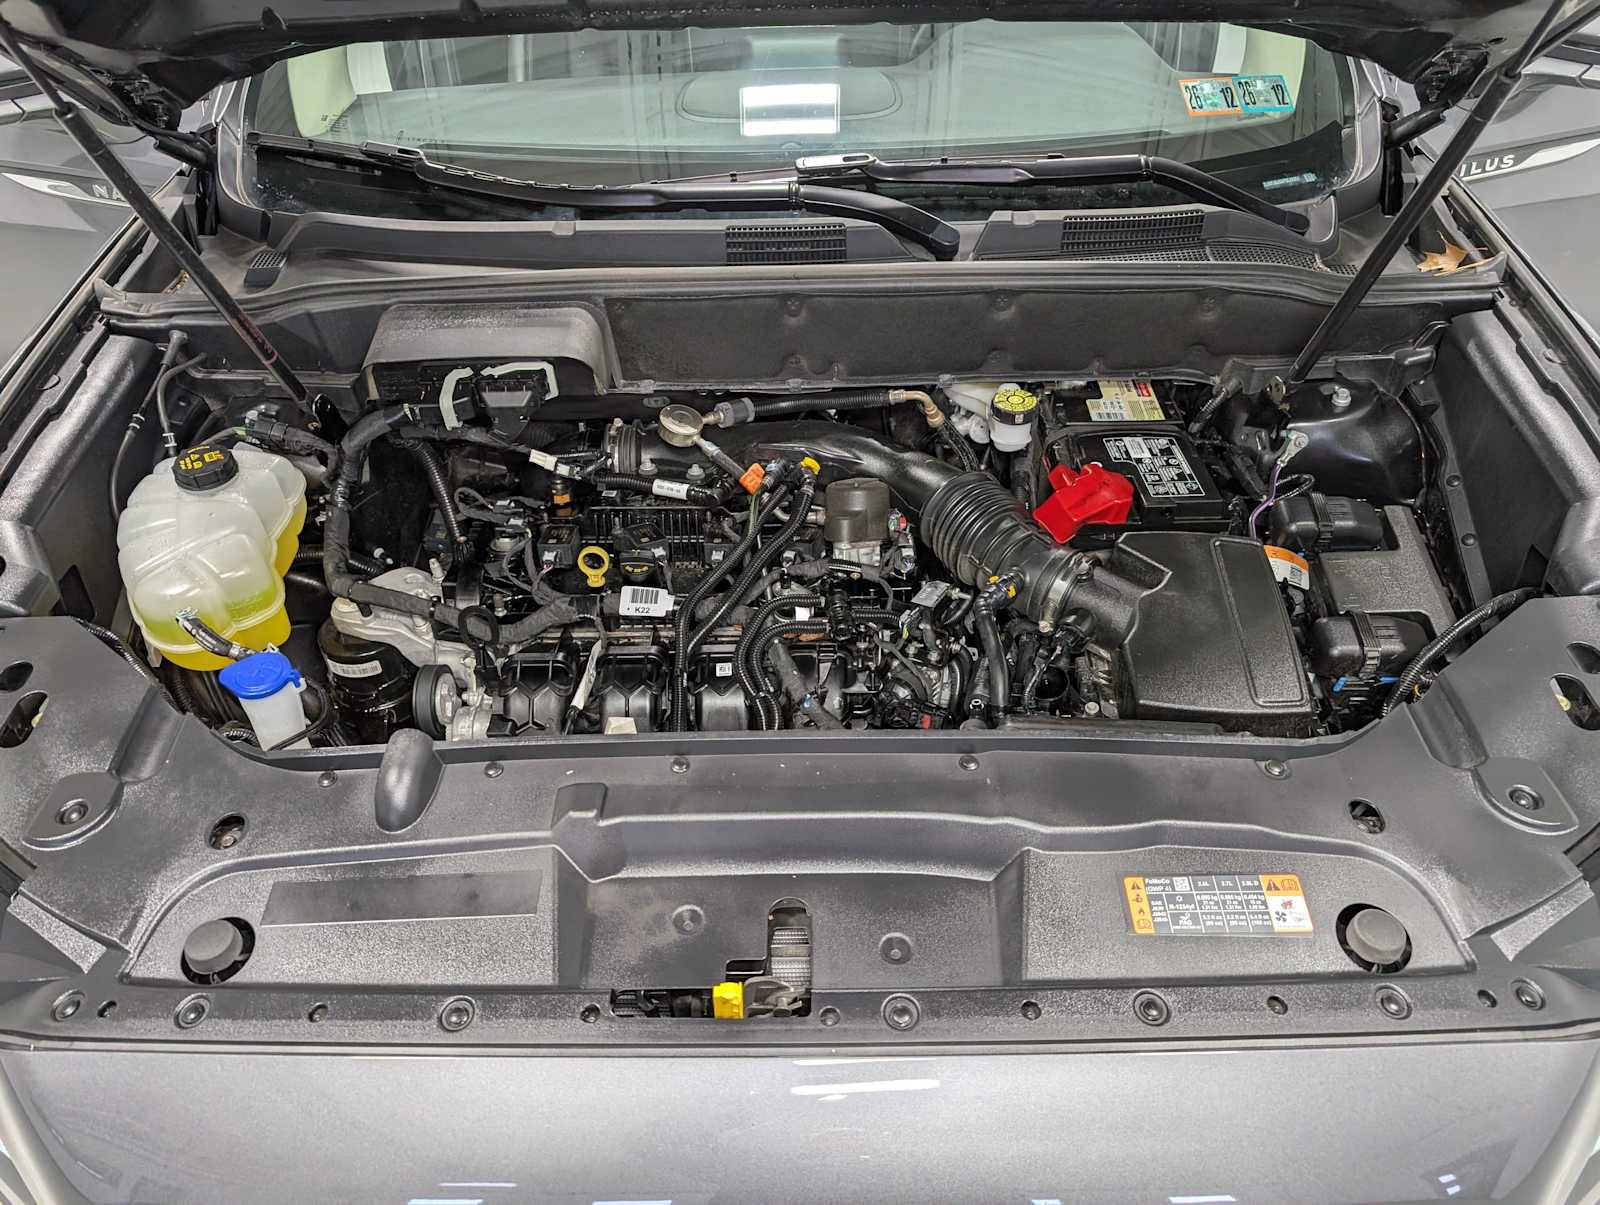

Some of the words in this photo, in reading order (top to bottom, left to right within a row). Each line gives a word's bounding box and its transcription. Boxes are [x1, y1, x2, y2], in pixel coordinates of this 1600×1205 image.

[1185, 85, 1203, 110] 26
[1219, 86, 1238, 109] 12
[1238, 81, 1257, 106] 26
[1271, 84, 1289, 106] 12
[1459, 154, 1516, 177] ILUS
[92, 183, 126, 201] NA
[634, 606, 651, 614] K22
